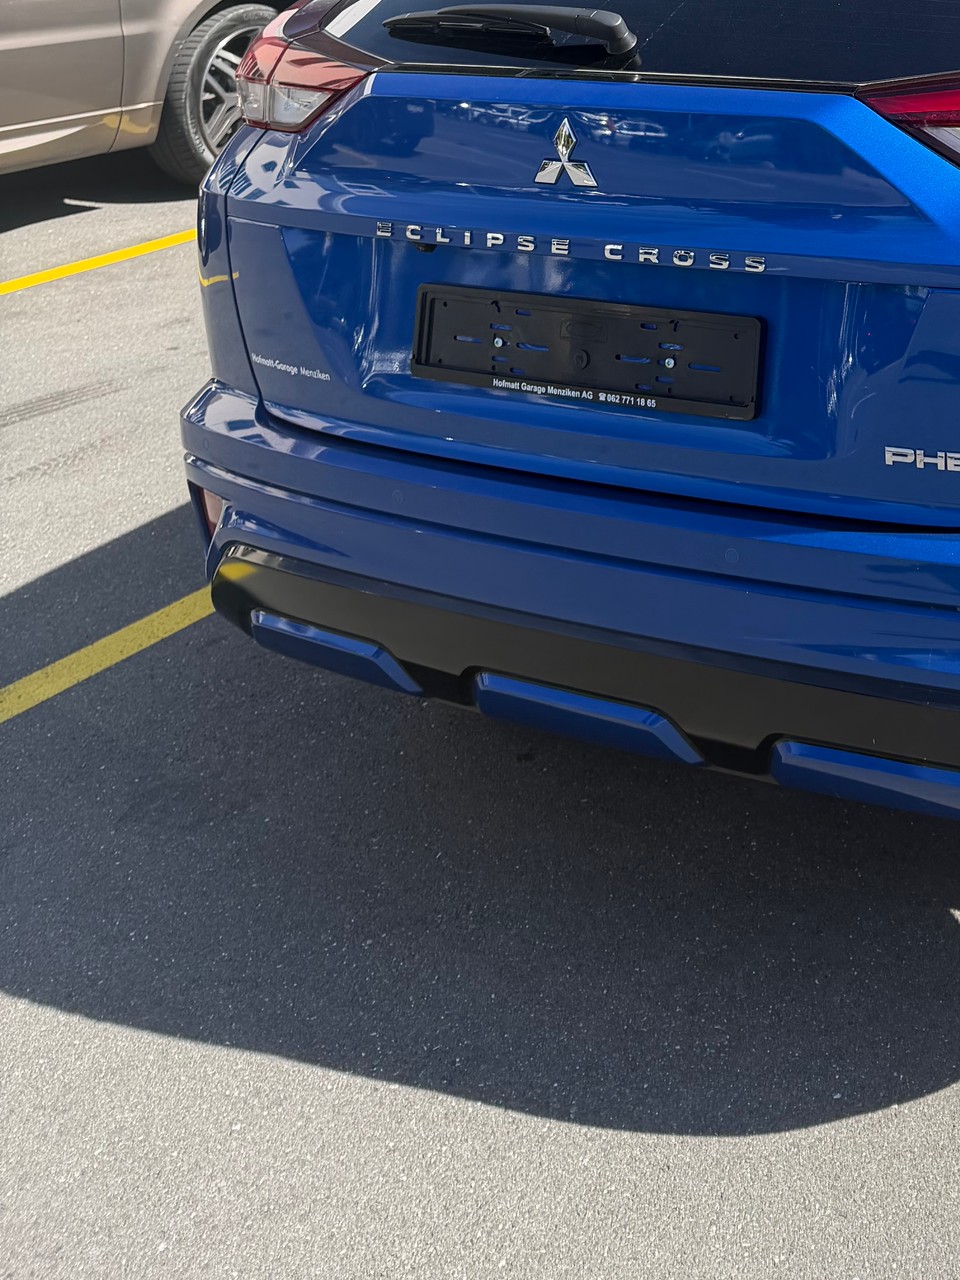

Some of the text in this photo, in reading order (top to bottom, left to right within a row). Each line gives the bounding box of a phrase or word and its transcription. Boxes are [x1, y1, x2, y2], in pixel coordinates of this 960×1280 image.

[376, 221, 767, 273] ECLIPSE CROSS
[492, 378, 656, 408] Hofmatt Garage Menziken AG 062 771 18 65
